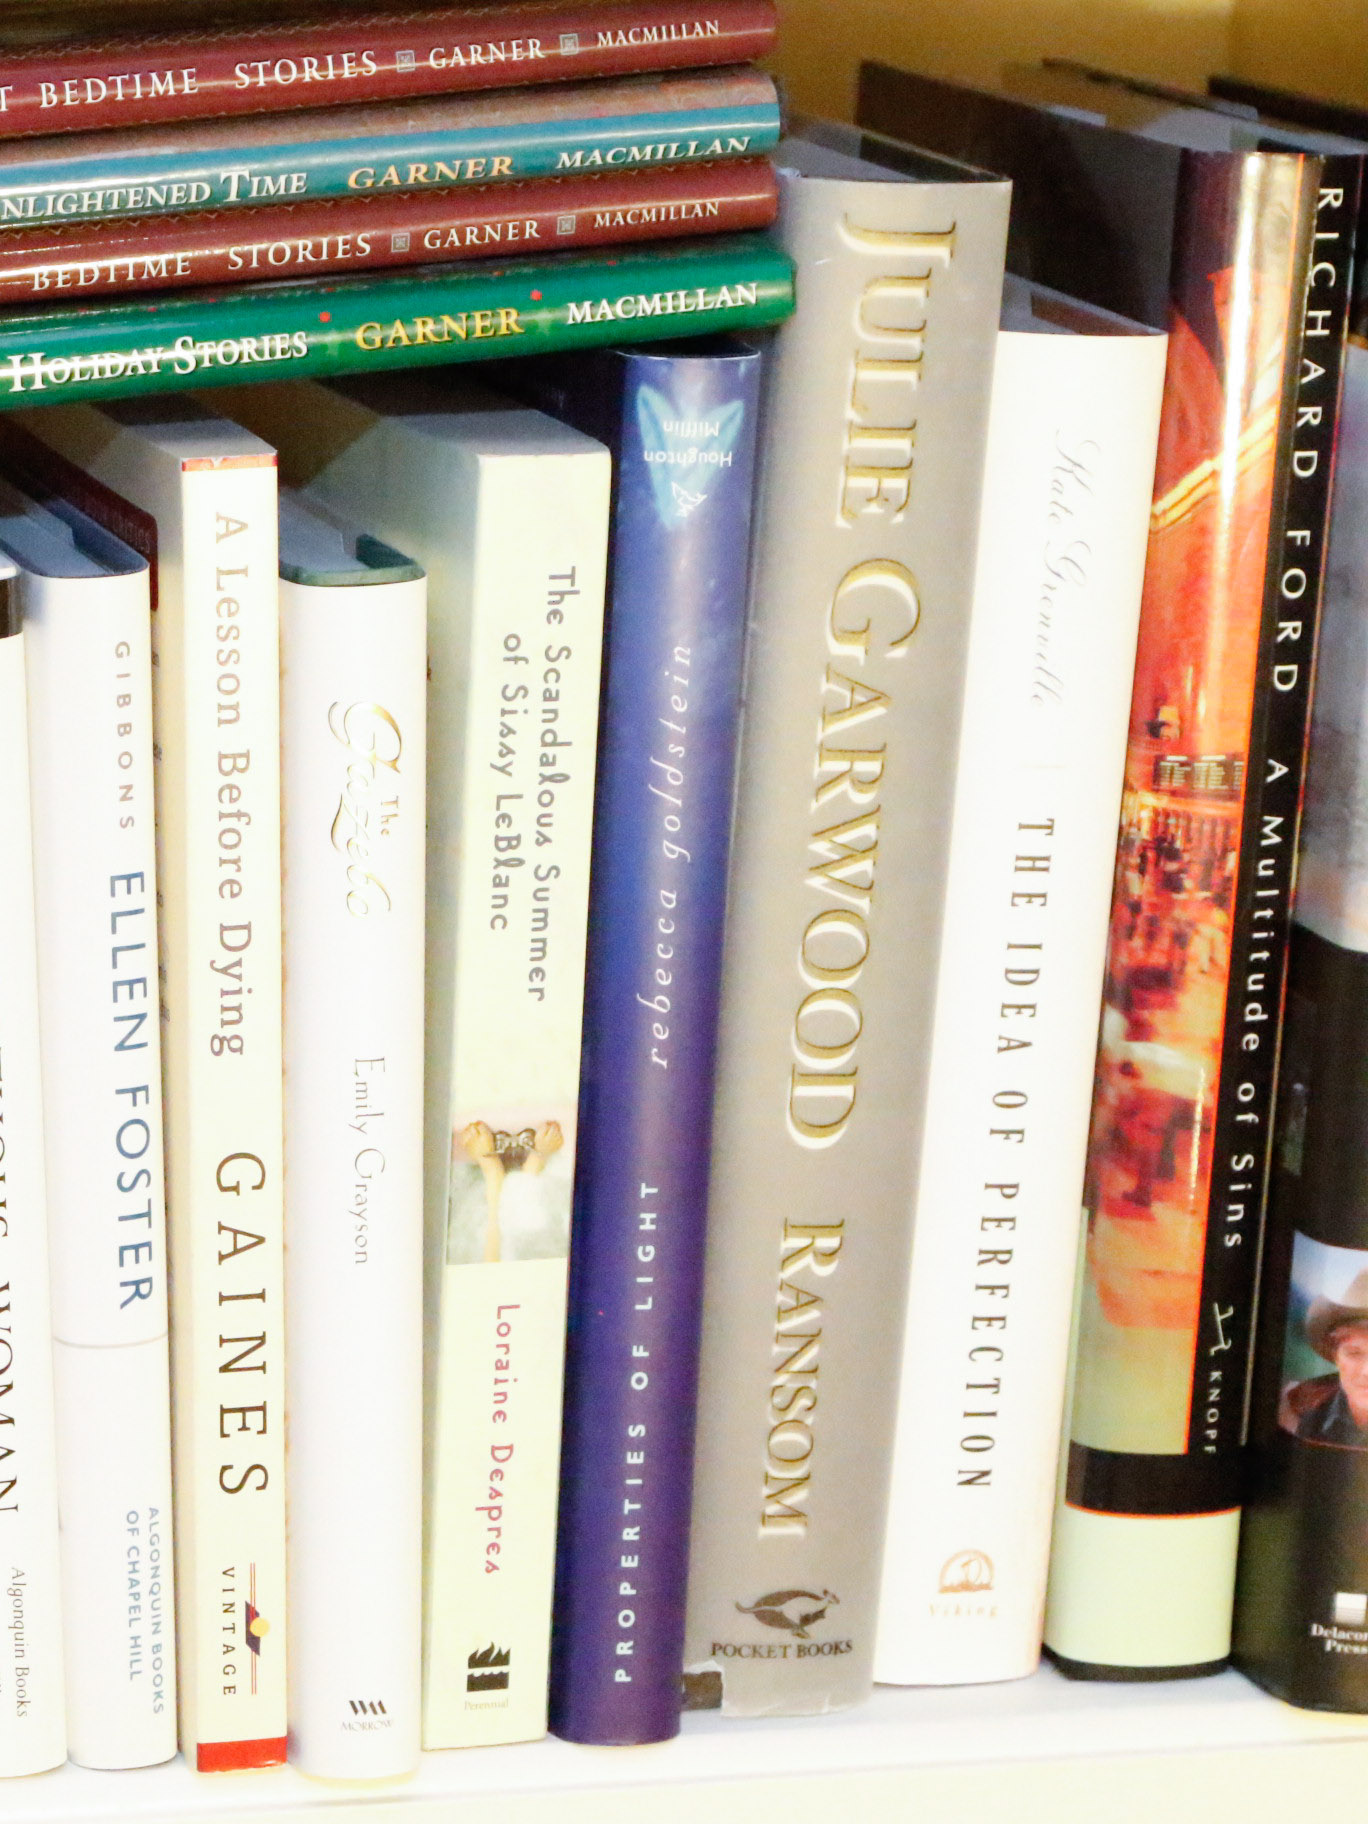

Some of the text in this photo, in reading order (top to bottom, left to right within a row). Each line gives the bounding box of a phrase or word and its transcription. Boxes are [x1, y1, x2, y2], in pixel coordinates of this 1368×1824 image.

[39, 67, 198, 110] BEDTIME
[234, 50, 377, 89] STORIES
[428, 37, 544, 70] GARNER
[597, 20, 719, 48] MACMILLAN
[32, 252, 191, 290] BEDTIME
[228, 233, 371, 270] STORIES
[424, 219, 540, 250] GARNER
[594, 201, 720, 229] MACMILLAN
[219, 167, 307, 203] TIME
[347, 155, 514, 190] GARNER
[556, 136, 751, 169] MACMILLAN
[8, 346, 164, 393] HOLIDAY
[174, 330, 308, 376] STORIES
[355, 307, 525, 351] GARNER
[567, 282, 757, 325] MACMILLAN
[643, 447, 733, 468] Houghton
[1047, 428, 1100, 524] Kate
[114, 641, 135, 830] GIBBONS
[210, 511, 253, 1058] A Lesson Before Dying
[327, 701, 402, 920] Gazebo
[381, 795, 399, 836] The
[490, 632, 529, 931] of Sissy LeBlanc
[528, 565, 581, 1003] The Scandalous Summer
[1224, 186, 1343, 1249] RICHARD FORD A Multitude of Sins
[636, 643, 692, 1069] rebecca goldstein
[758, 212, 957, 1538] JULIE GARWOOD RANSOM
[110, 871, 153, 1310] ELLEN FOSTER
[349, 1056, 386, 1266] Emily Grayson
[956, 816, 1056, 1487] THE IDEA OF PERFECTION
[216, 1152, 269, 1495] GAINES
[1204, 1371, 1223, 1454] KNOPF
[474, 1303, 521, 1575] Loraine Despres
[614, 1182, 659, 1682] PROPERTIES OF LIGHT
[9, 1566, 29, 1718] Algonquin Books
[126, 1510, 141, 1681] OF CHAPEL HILL
[149, 1507, 165, 1714] ALGONQUIN BOOKS
[221, 1566, 237, 1697] VINTAGE
[710, 1640, 853, 1659] POCKET BOOKS
